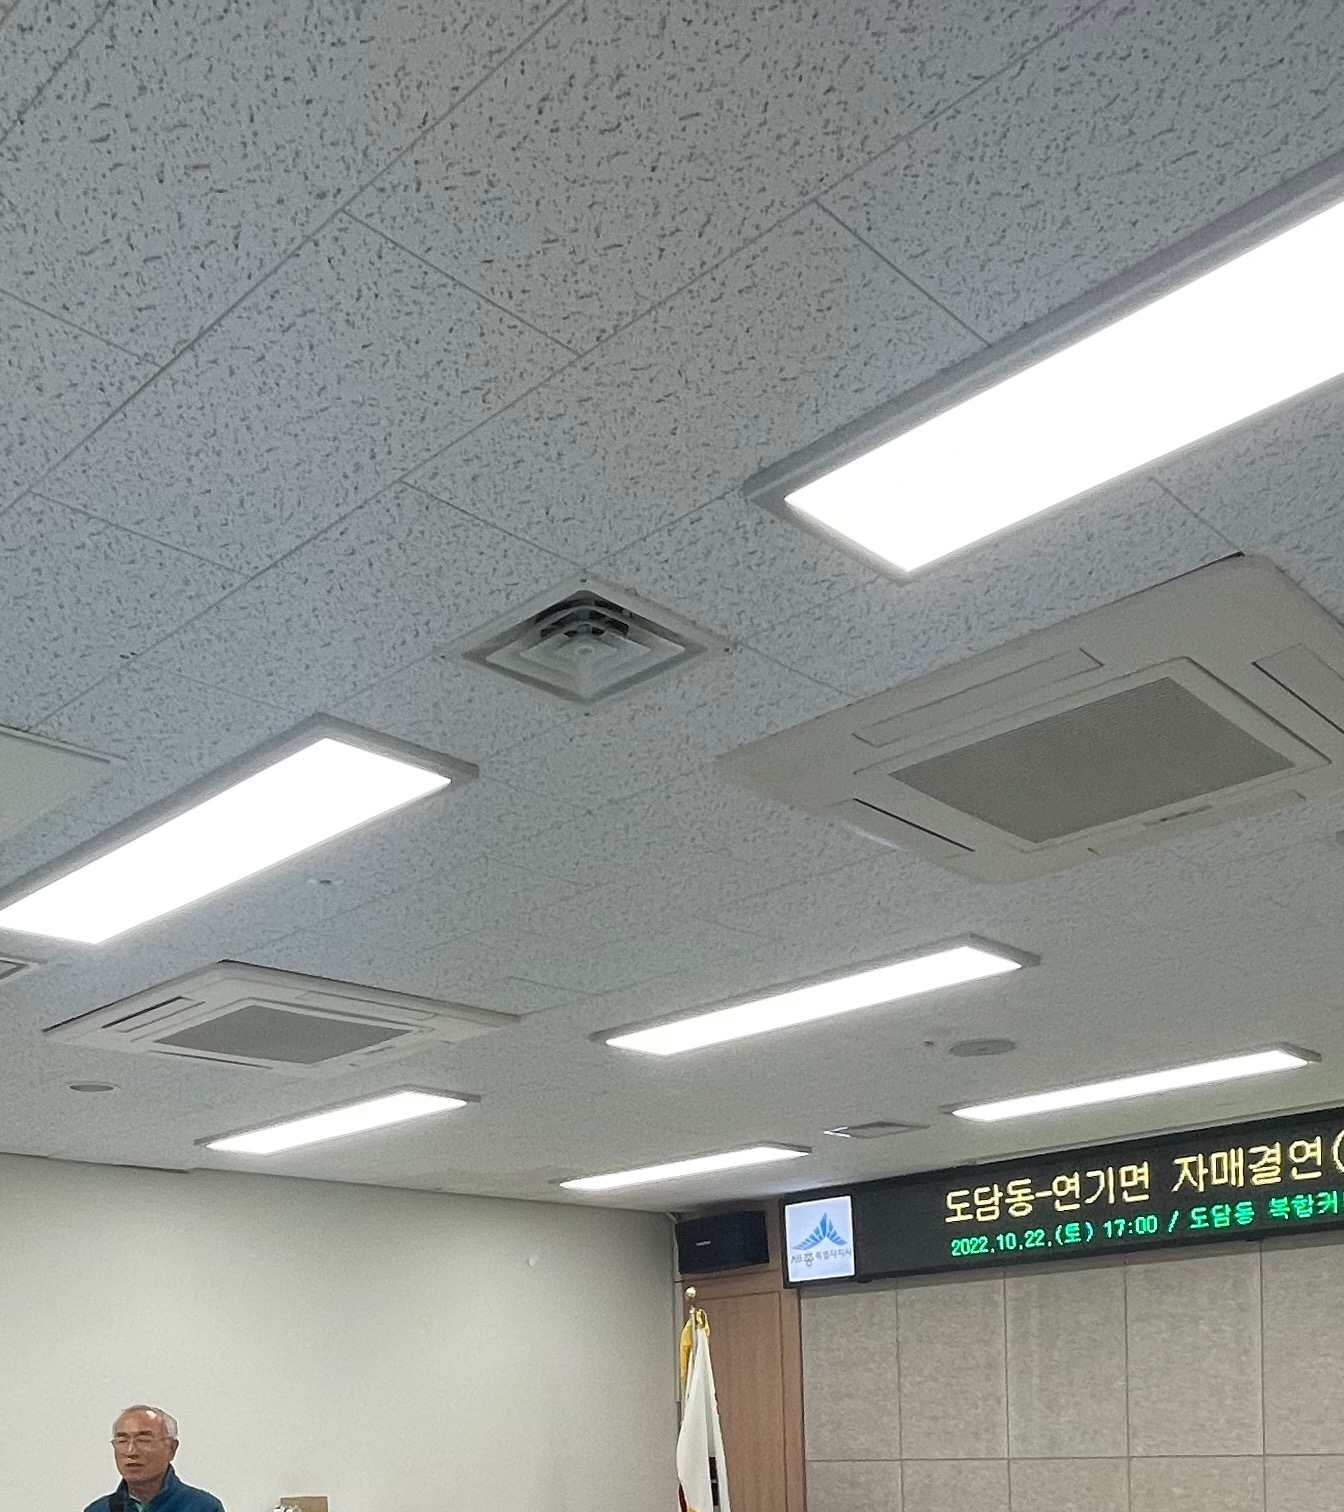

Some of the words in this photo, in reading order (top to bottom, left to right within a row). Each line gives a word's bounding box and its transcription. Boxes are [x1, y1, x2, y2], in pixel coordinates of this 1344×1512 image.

[944, 1160, 1151, 1224] 도담동-연기면
[950, 1220, 1095, 1257] 2022.10.22.(토)
[1102, 1214, 1158, 1238] 17:00
[1189, 1200, 1256, 1231] 도담동
